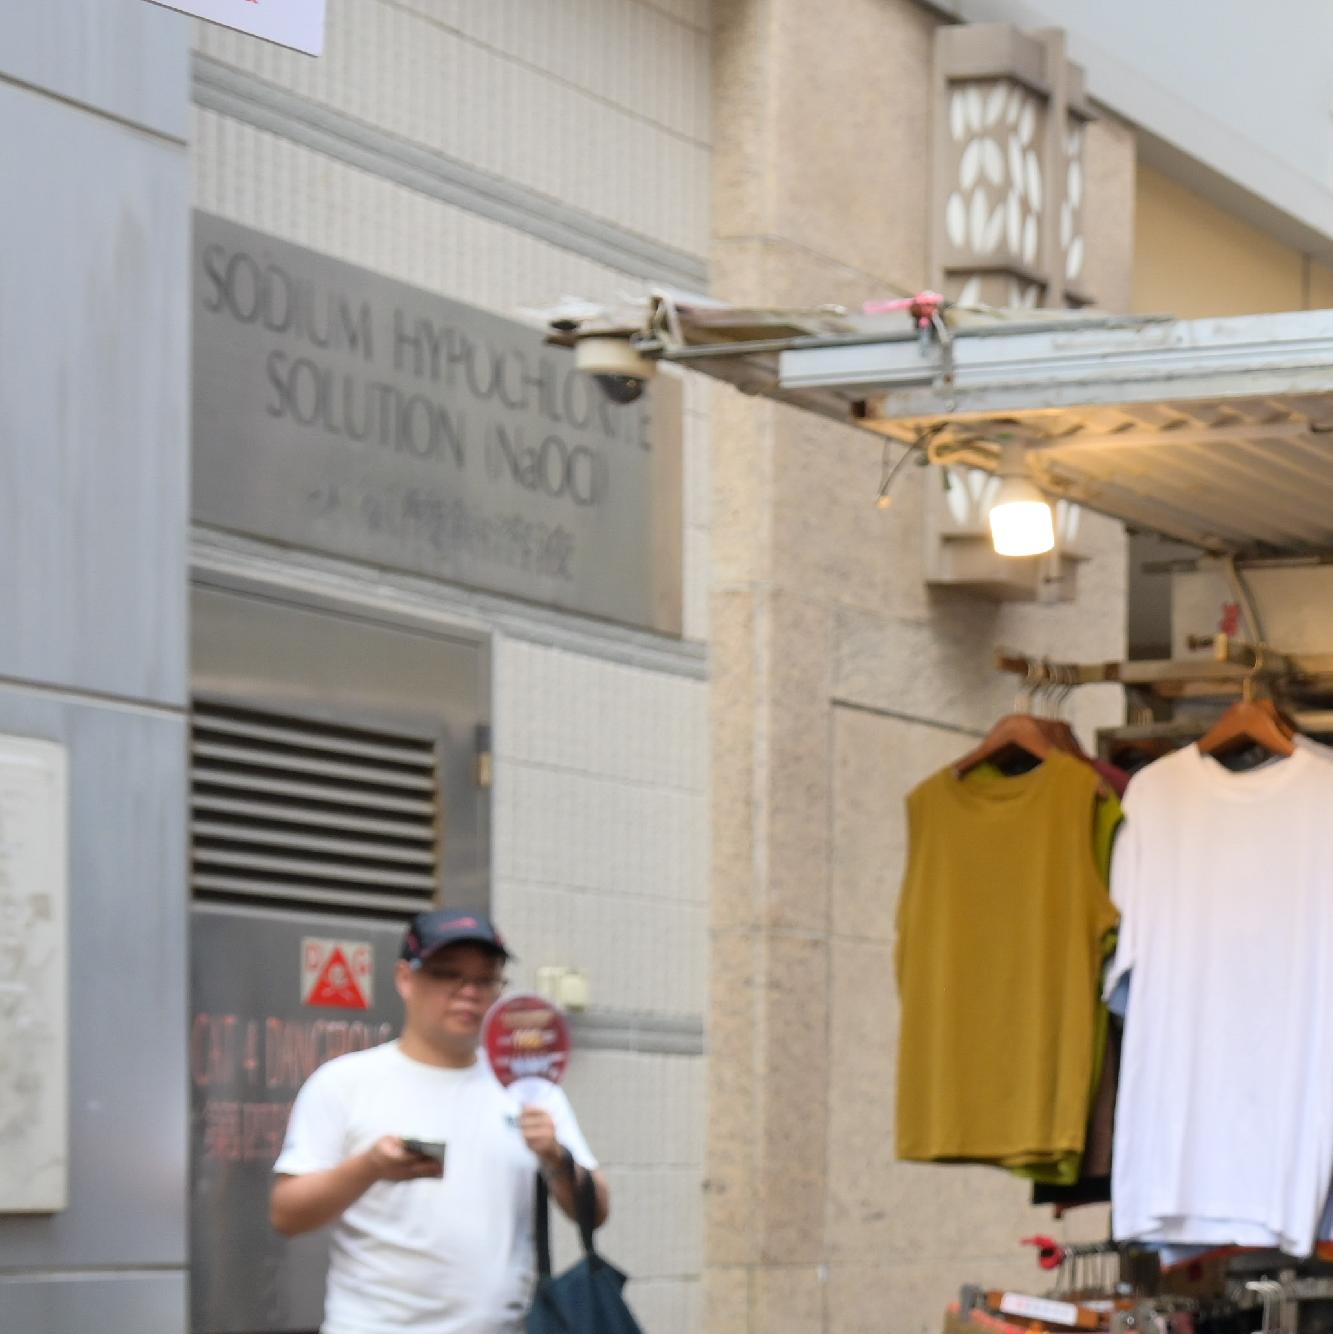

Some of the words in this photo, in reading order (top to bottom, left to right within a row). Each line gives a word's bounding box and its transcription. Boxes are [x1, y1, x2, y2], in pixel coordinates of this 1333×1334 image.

[203, 243, 373, 362] SODIUM
[393, 314, 652, 451] HYPOCHLOE
[266, 349, 465, 469] SOLUTION
[265, 1016, 393, 1088] DANGE
